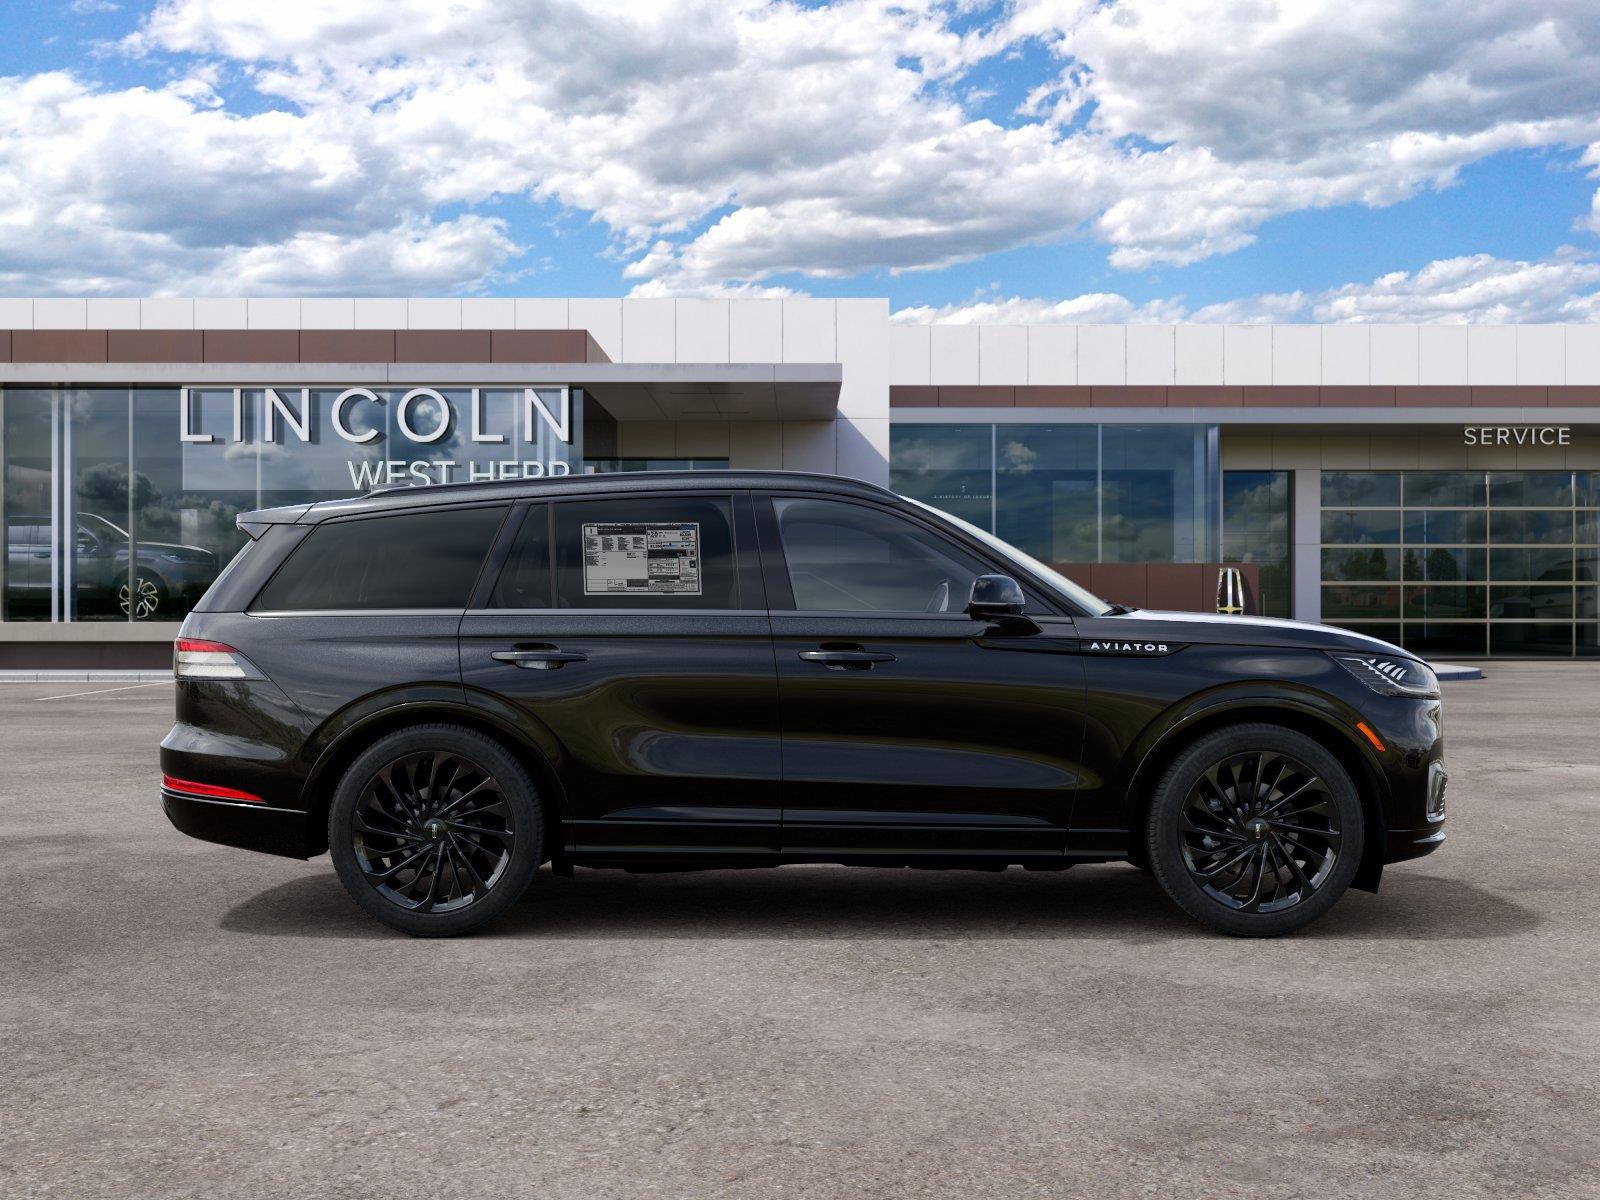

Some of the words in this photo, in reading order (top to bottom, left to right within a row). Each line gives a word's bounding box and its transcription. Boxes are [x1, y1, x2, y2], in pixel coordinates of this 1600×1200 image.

[180, 388, 570, 443] LINCOLN
[1464, 427, 1571, 445] SERVICE
[347, 460, 456, 490] WEST
[1090, 642, 1168, 652] AVIATOR
